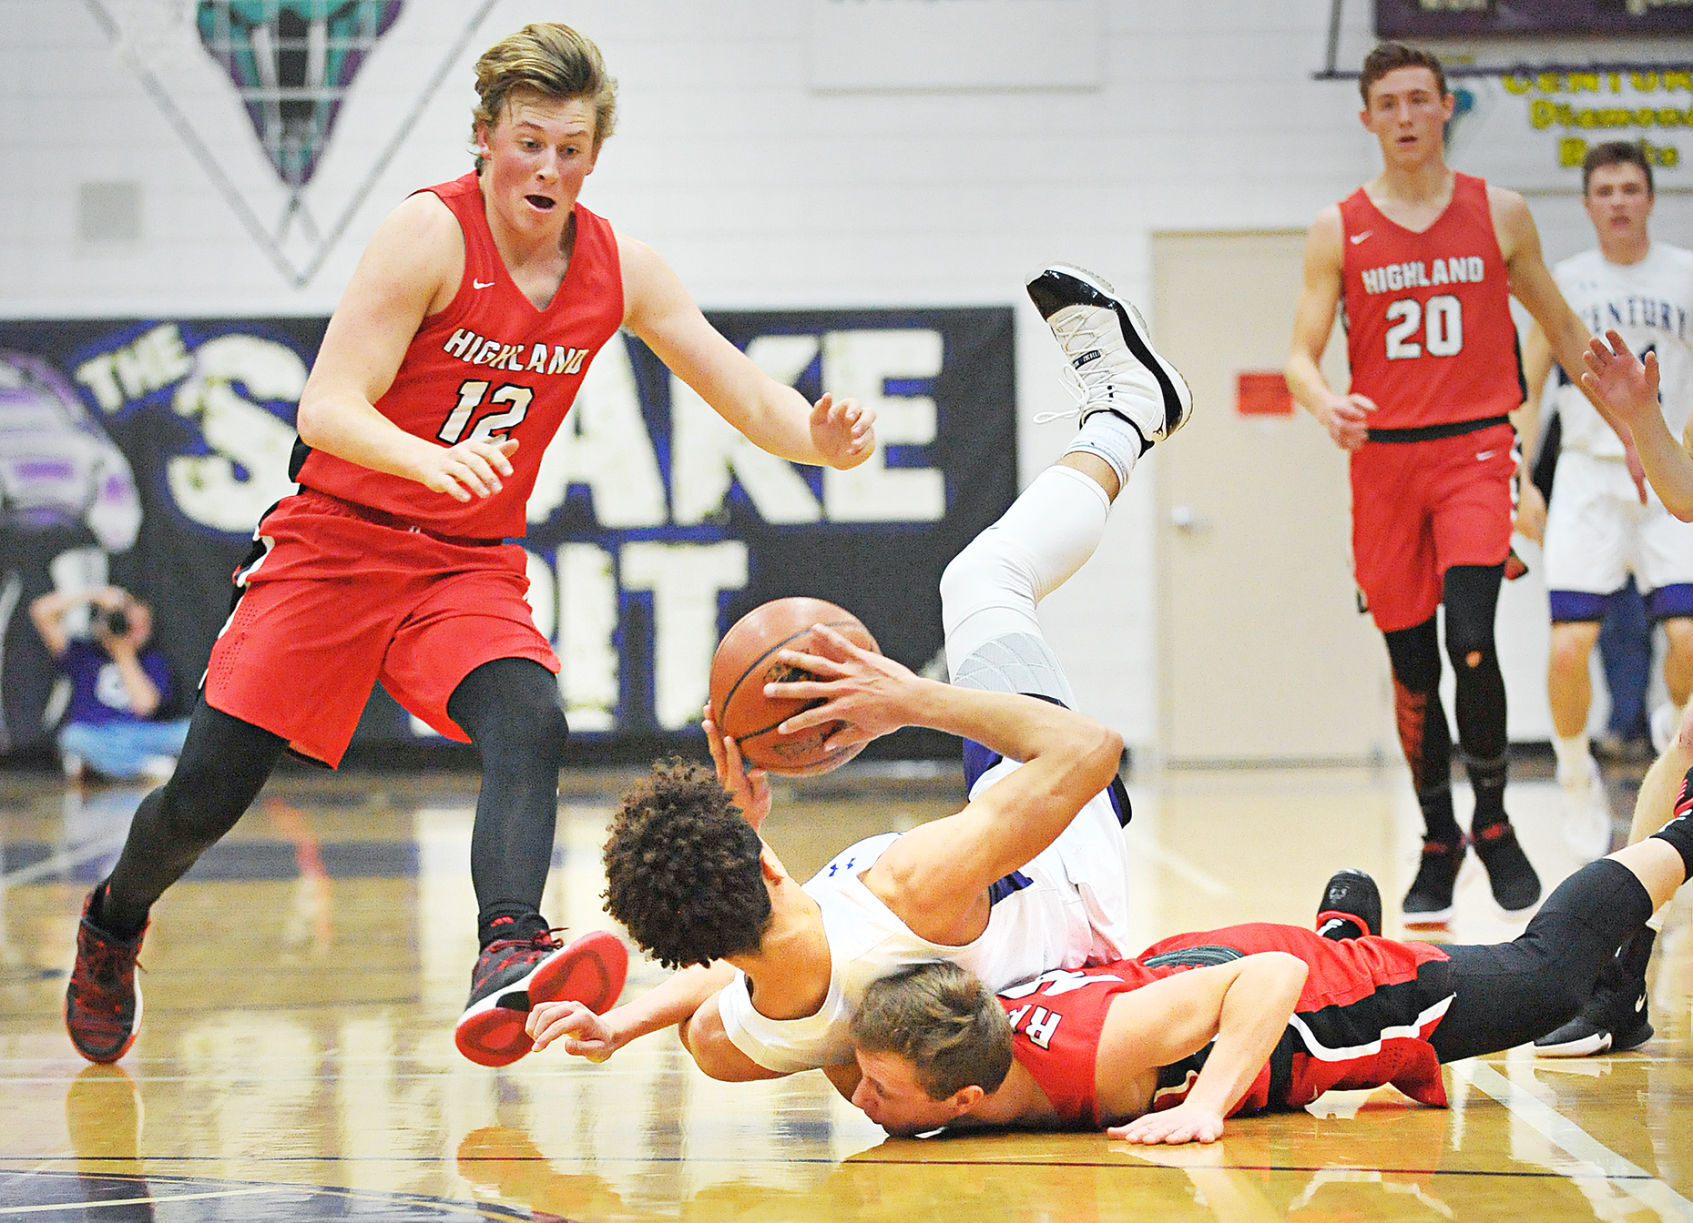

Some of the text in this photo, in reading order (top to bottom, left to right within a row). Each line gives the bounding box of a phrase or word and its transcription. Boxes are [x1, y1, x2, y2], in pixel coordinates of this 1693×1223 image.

[1361, 256, 1484, 295] HIGHLAND
[443, 328, 589, 375] HIGHLAND
[1385, 294, 1463, 360] 20
[76, 323, 195, 413] THE
[166, 328, 946, 532] SAKE
[436, 378, 535, 446] 12
[408, 540, 748, 733] IT
